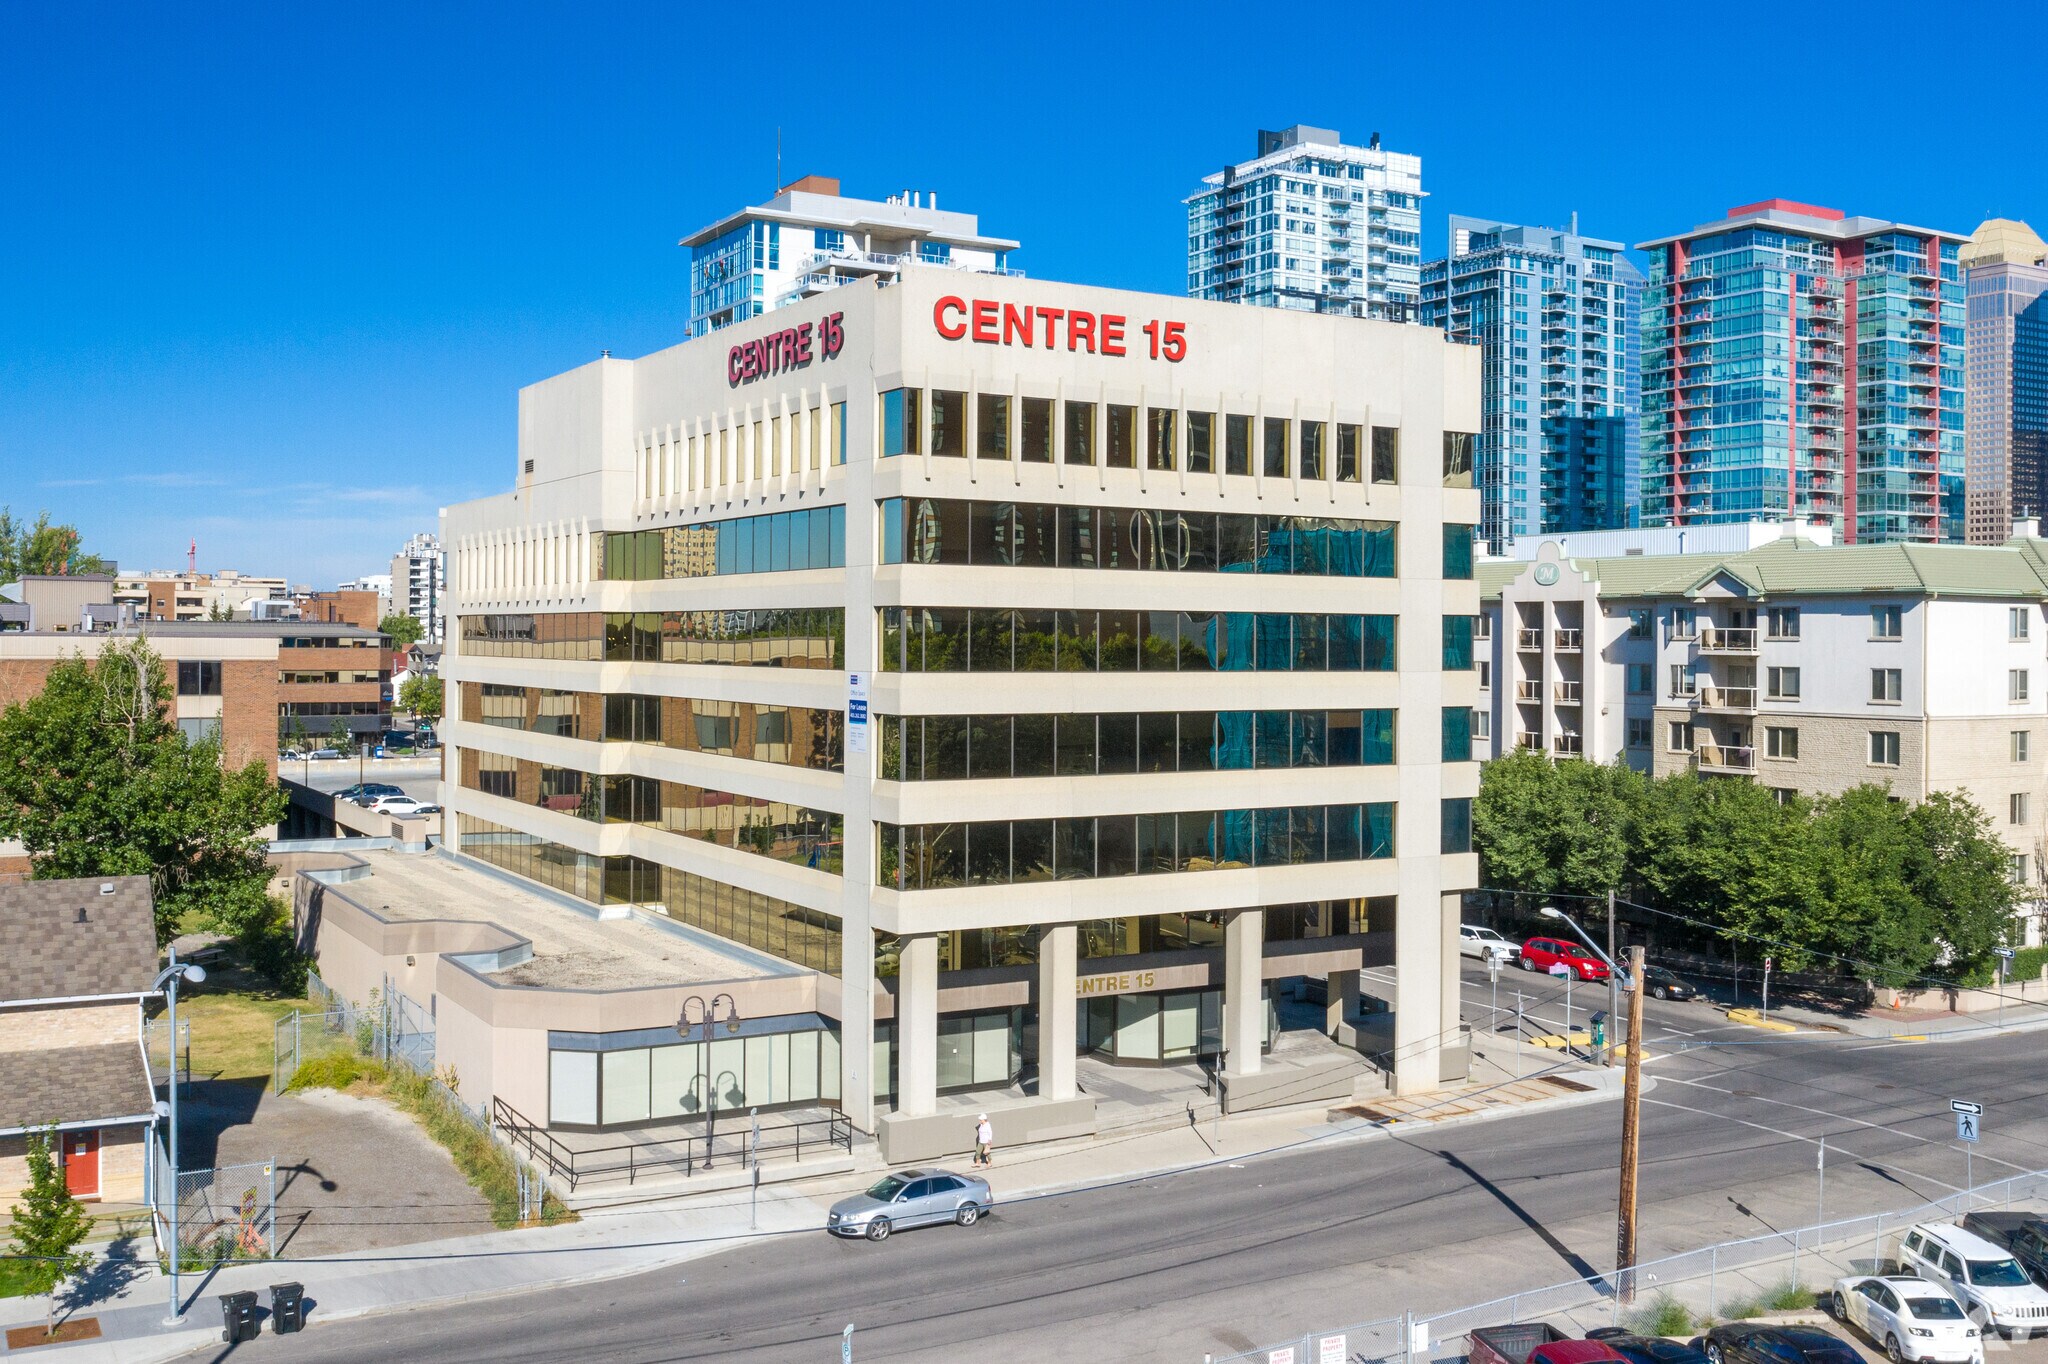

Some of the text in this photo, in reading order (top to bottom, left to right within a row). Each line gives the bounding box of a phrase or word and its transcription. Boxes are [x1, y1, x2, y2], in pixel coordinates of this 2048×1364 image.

[728, 311, 844, 383] CENTRE 15
[933, 295, 1188, 361] CENTRE 15
[1076, 972, 1154, 993] ENTRE 15
[1323, 1344, 1343, 1352] PROPERTY
